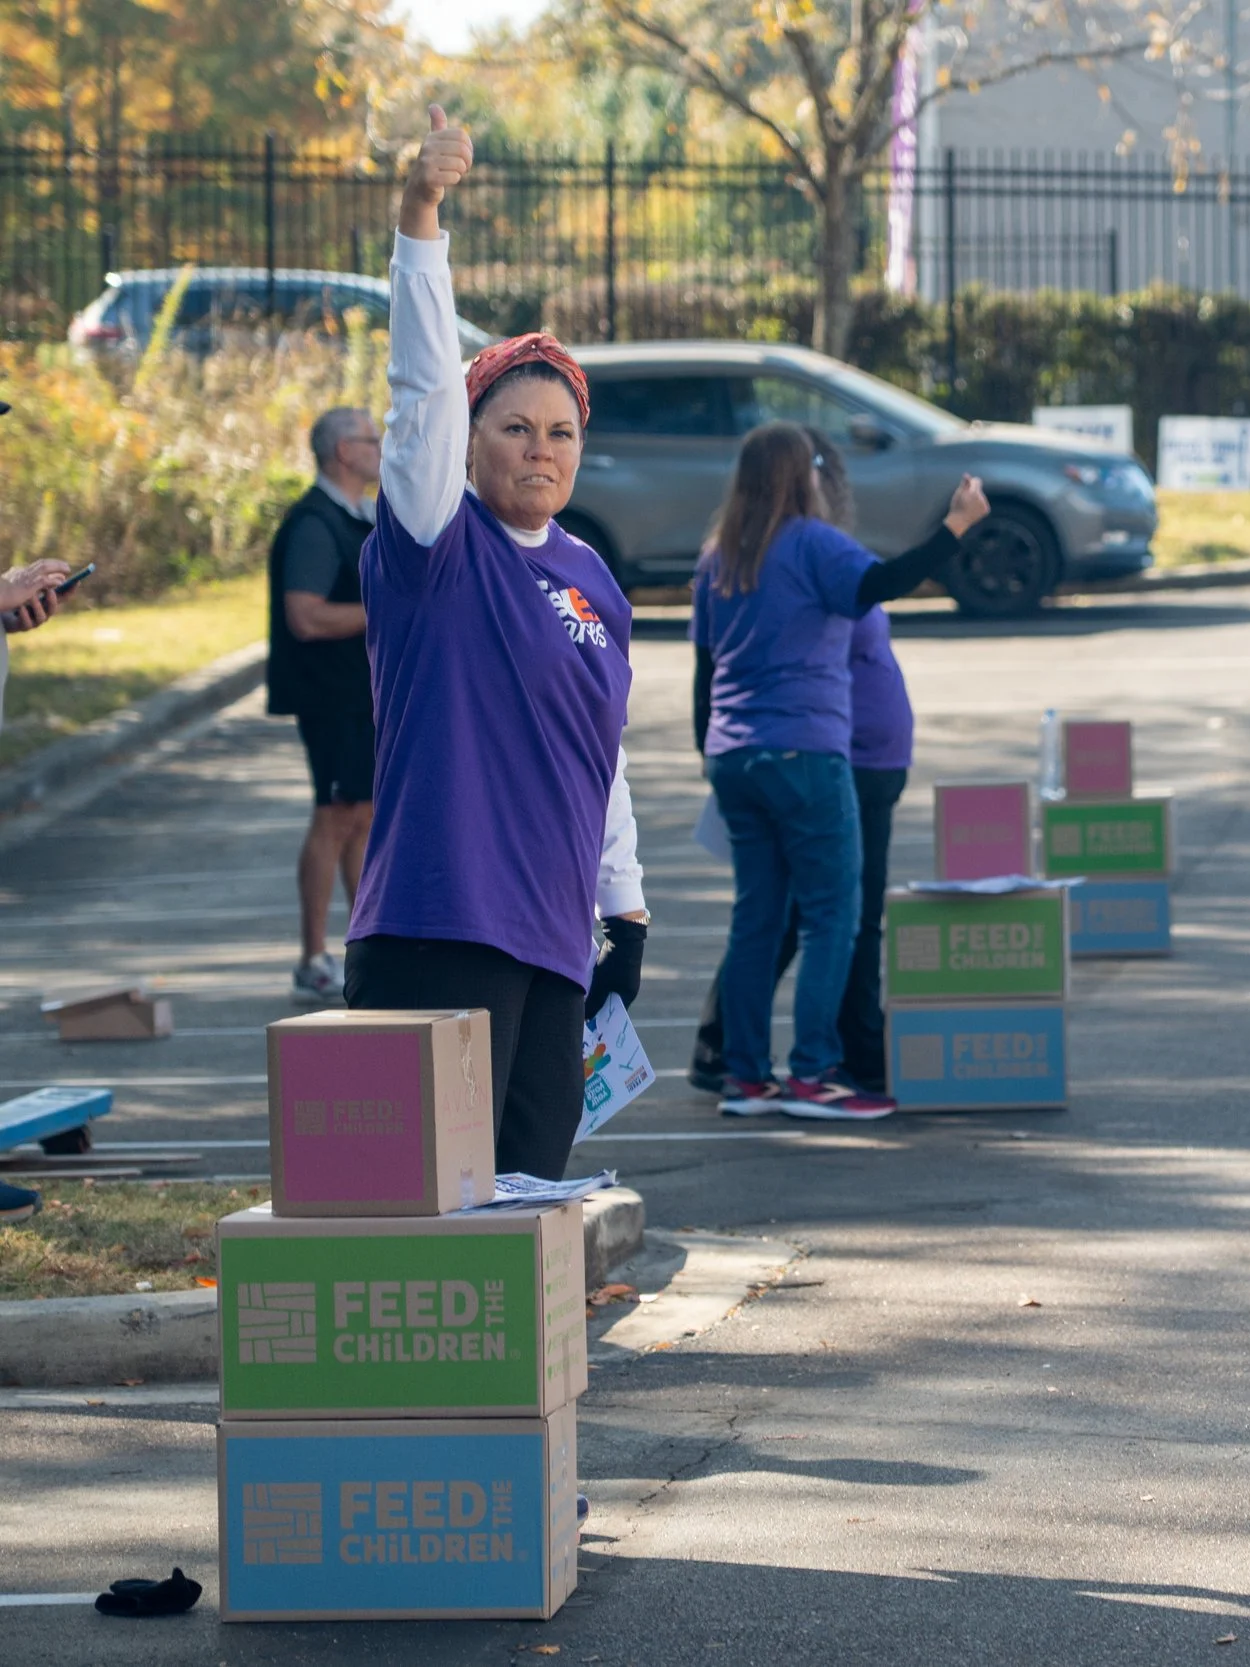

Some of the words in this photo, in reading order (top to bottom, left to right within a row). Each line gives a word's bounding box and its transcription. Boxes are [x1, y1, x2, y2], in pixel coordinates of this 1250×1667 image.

[949, 923, 1030, 949] FEED
[953, 1032, 1034, 1059] FEED
[333, 1100, 394, 1121] FEED
[333, 1280, 480, 1329] FEED
[484, 1279, 505, 1328] THE
[333, 1332, 506, 1363] CHiLDREN
[339, 1480, 488, 1529] FEED
[492, 1479, 513, 1528] THE
[339, 1532, 513, 1564] CHiLDREN
